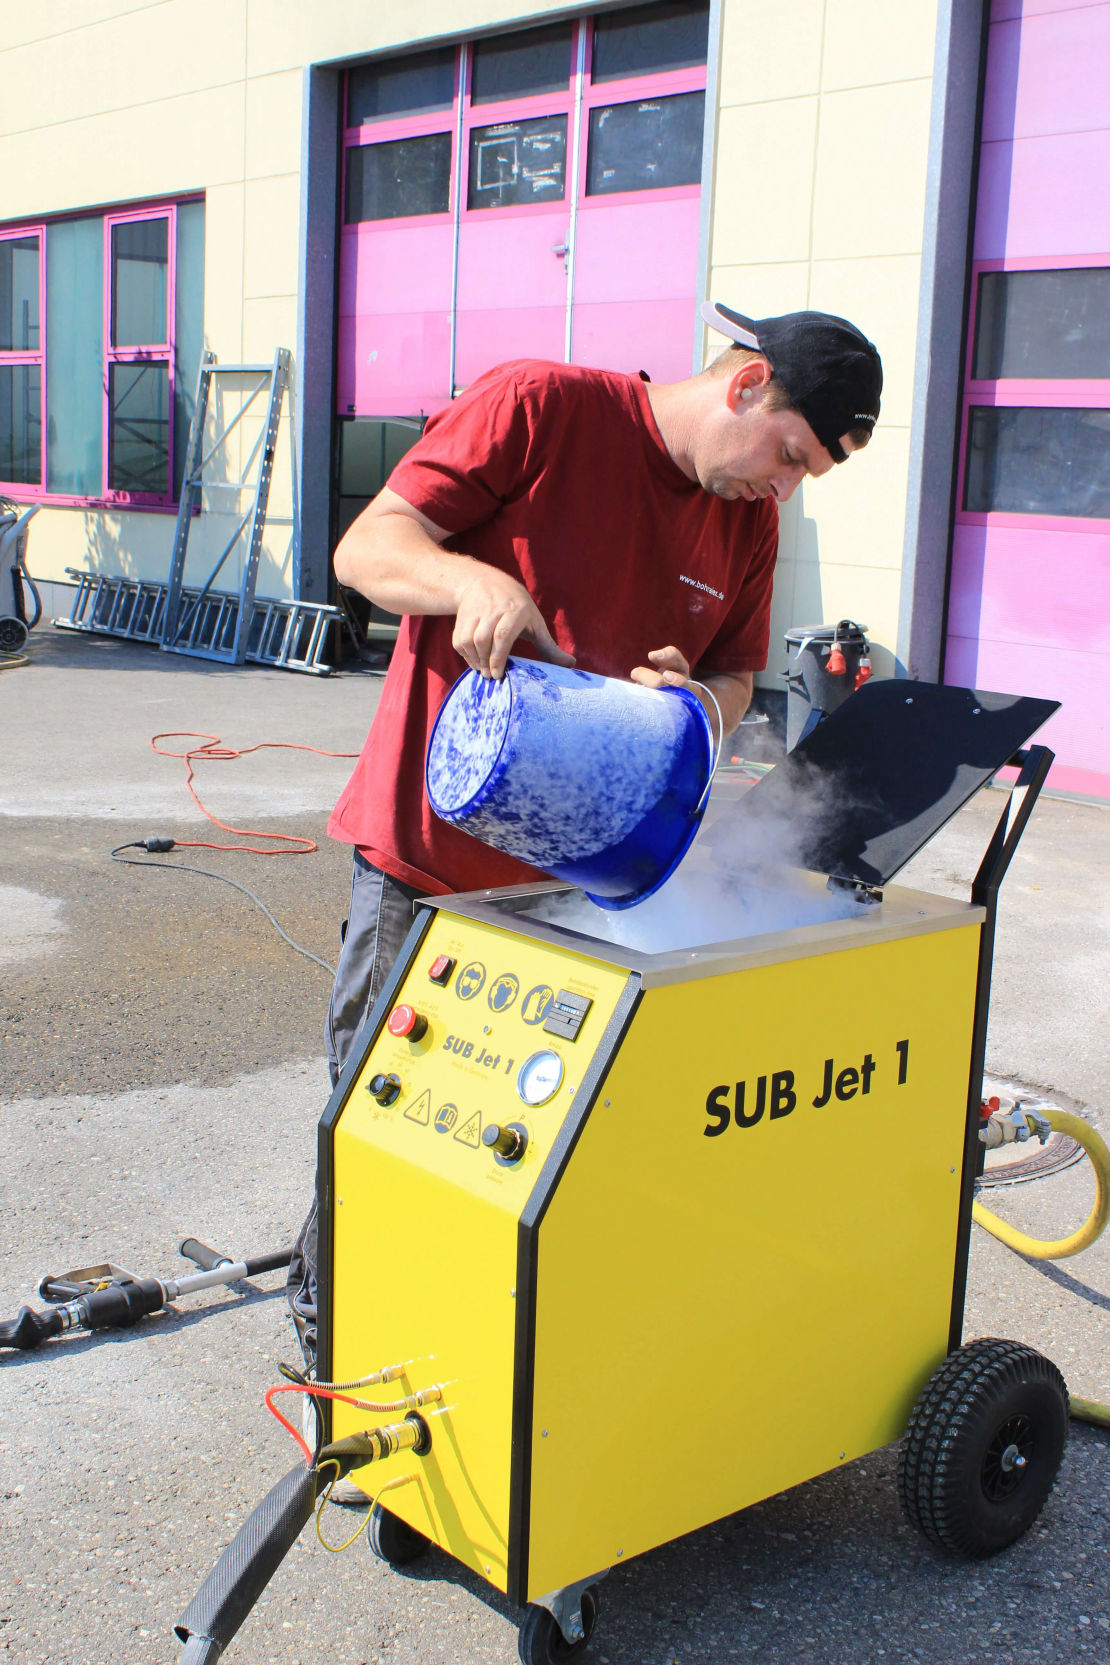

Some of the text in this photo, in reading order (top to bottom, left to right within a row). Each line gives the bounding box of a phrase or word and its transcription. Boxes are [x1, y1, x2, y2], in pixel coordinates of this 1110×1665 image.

[443, 1035, 474, 1058] SUB
[475, 1048, 501, 1069] Jet
[505, 1058, 514, 1074] 1
[703, 1039, 909, 1137] SUB Jet 1
